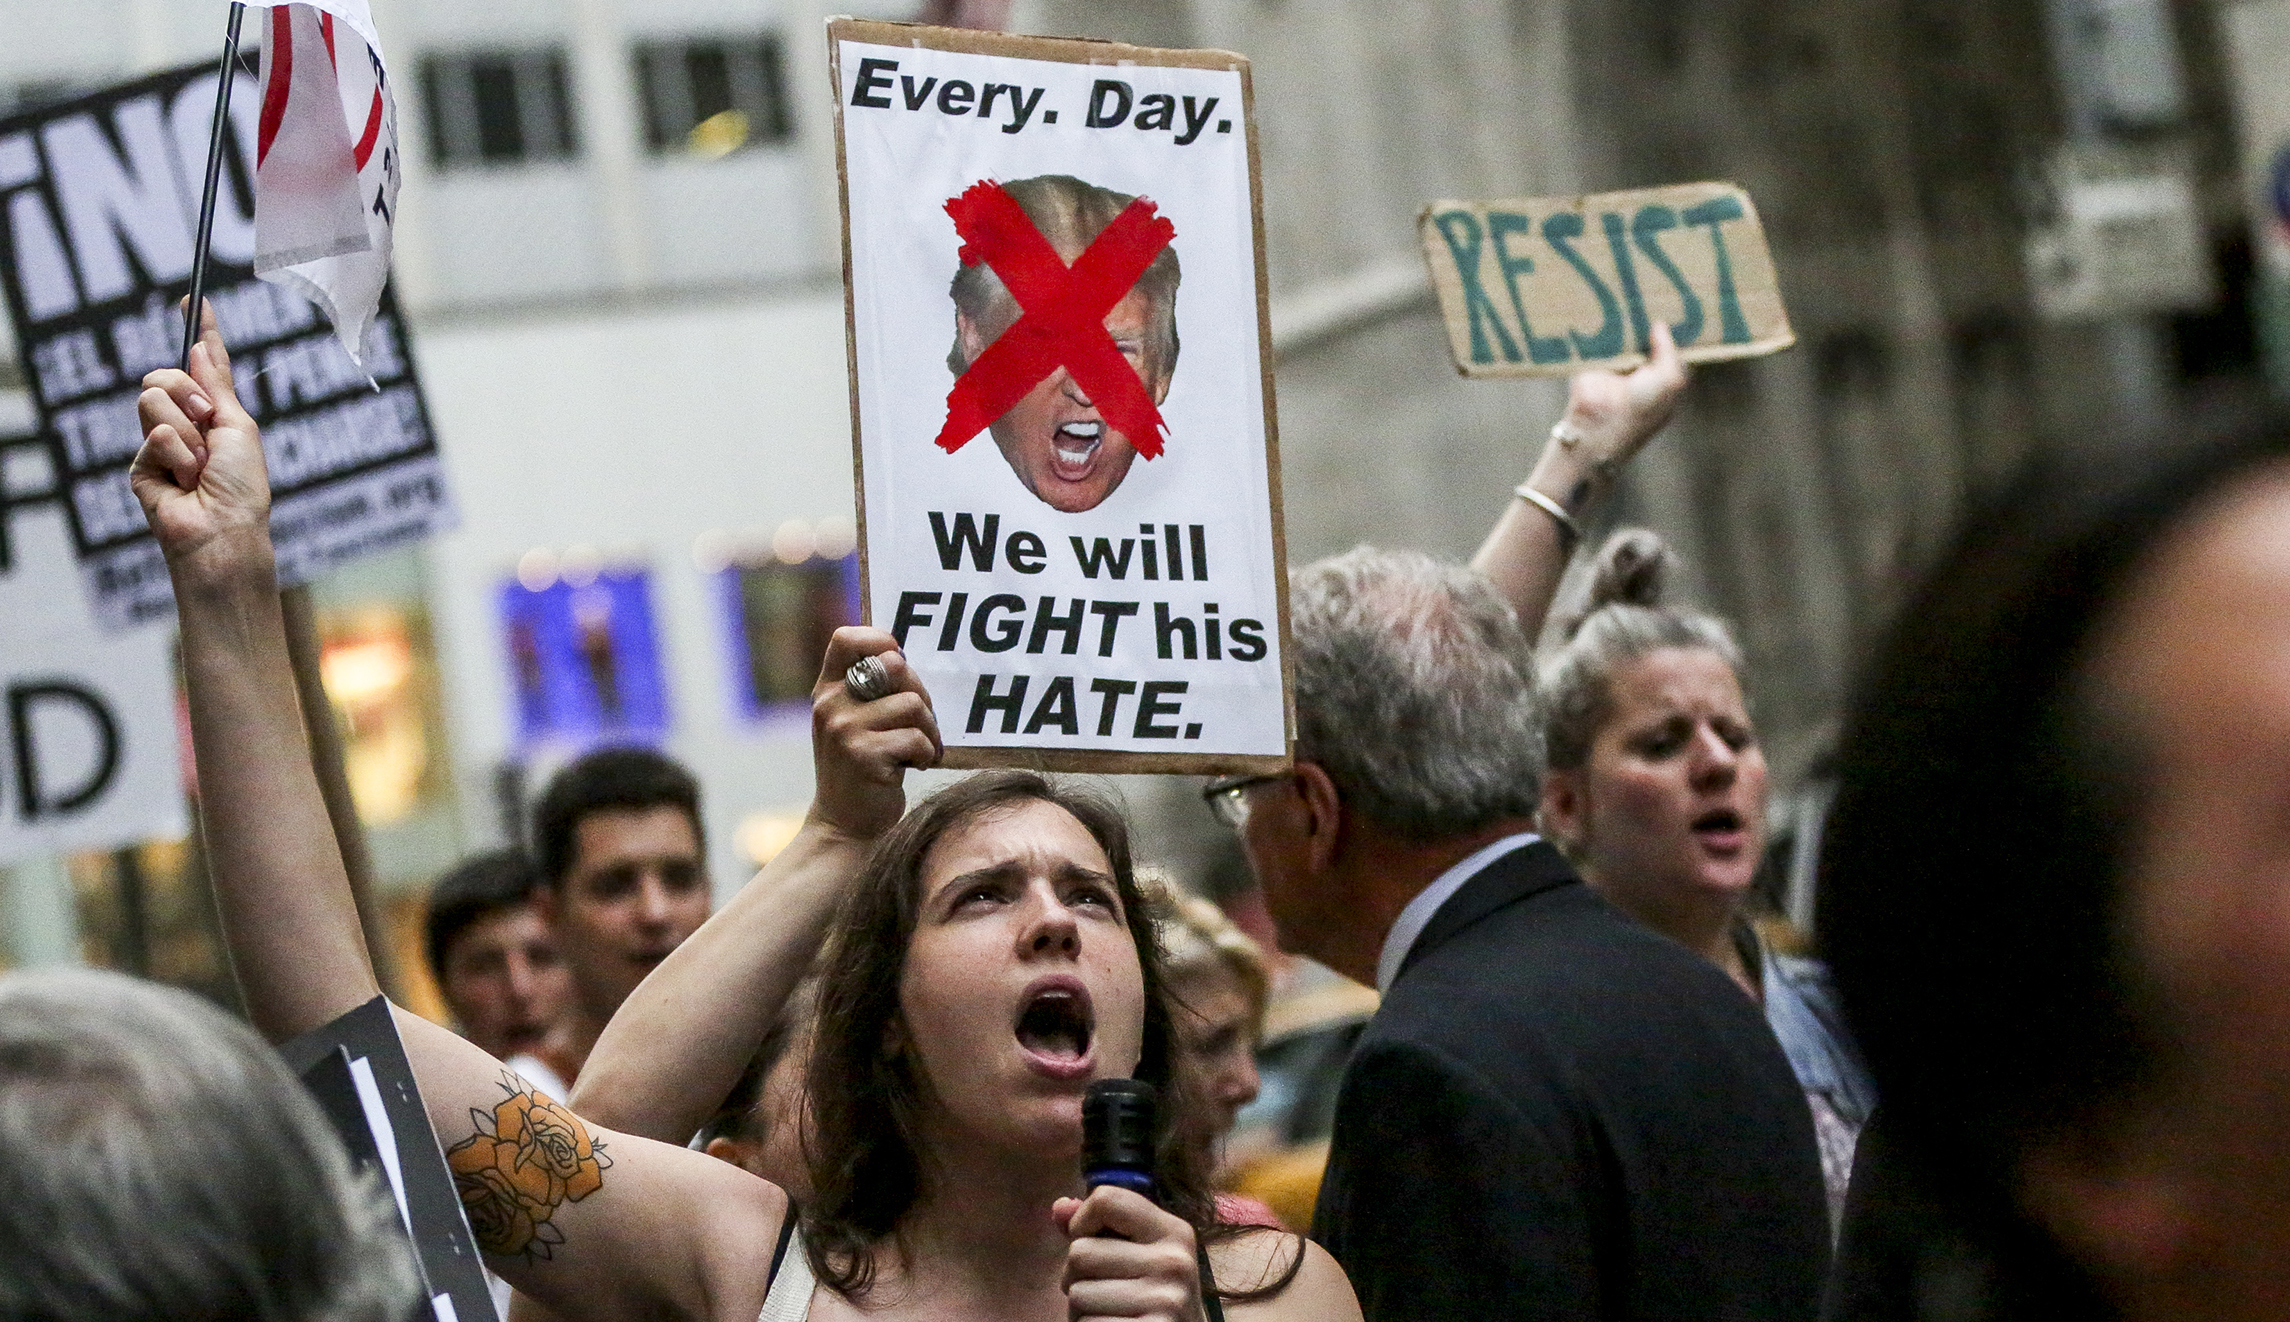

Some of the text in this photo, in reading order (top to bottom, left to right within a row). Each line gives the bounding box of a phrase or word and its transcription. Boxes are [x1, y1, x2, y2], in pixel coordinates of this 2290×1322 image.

[850, 57, 1233, 145] Every. Day.
[1433, 196, 1752, 364] RESIST
[927, 511, 1209, 581] We will
[891, 591, 1268, 662] FIGHT his
[965, 674, 1204, 740] HATE.
